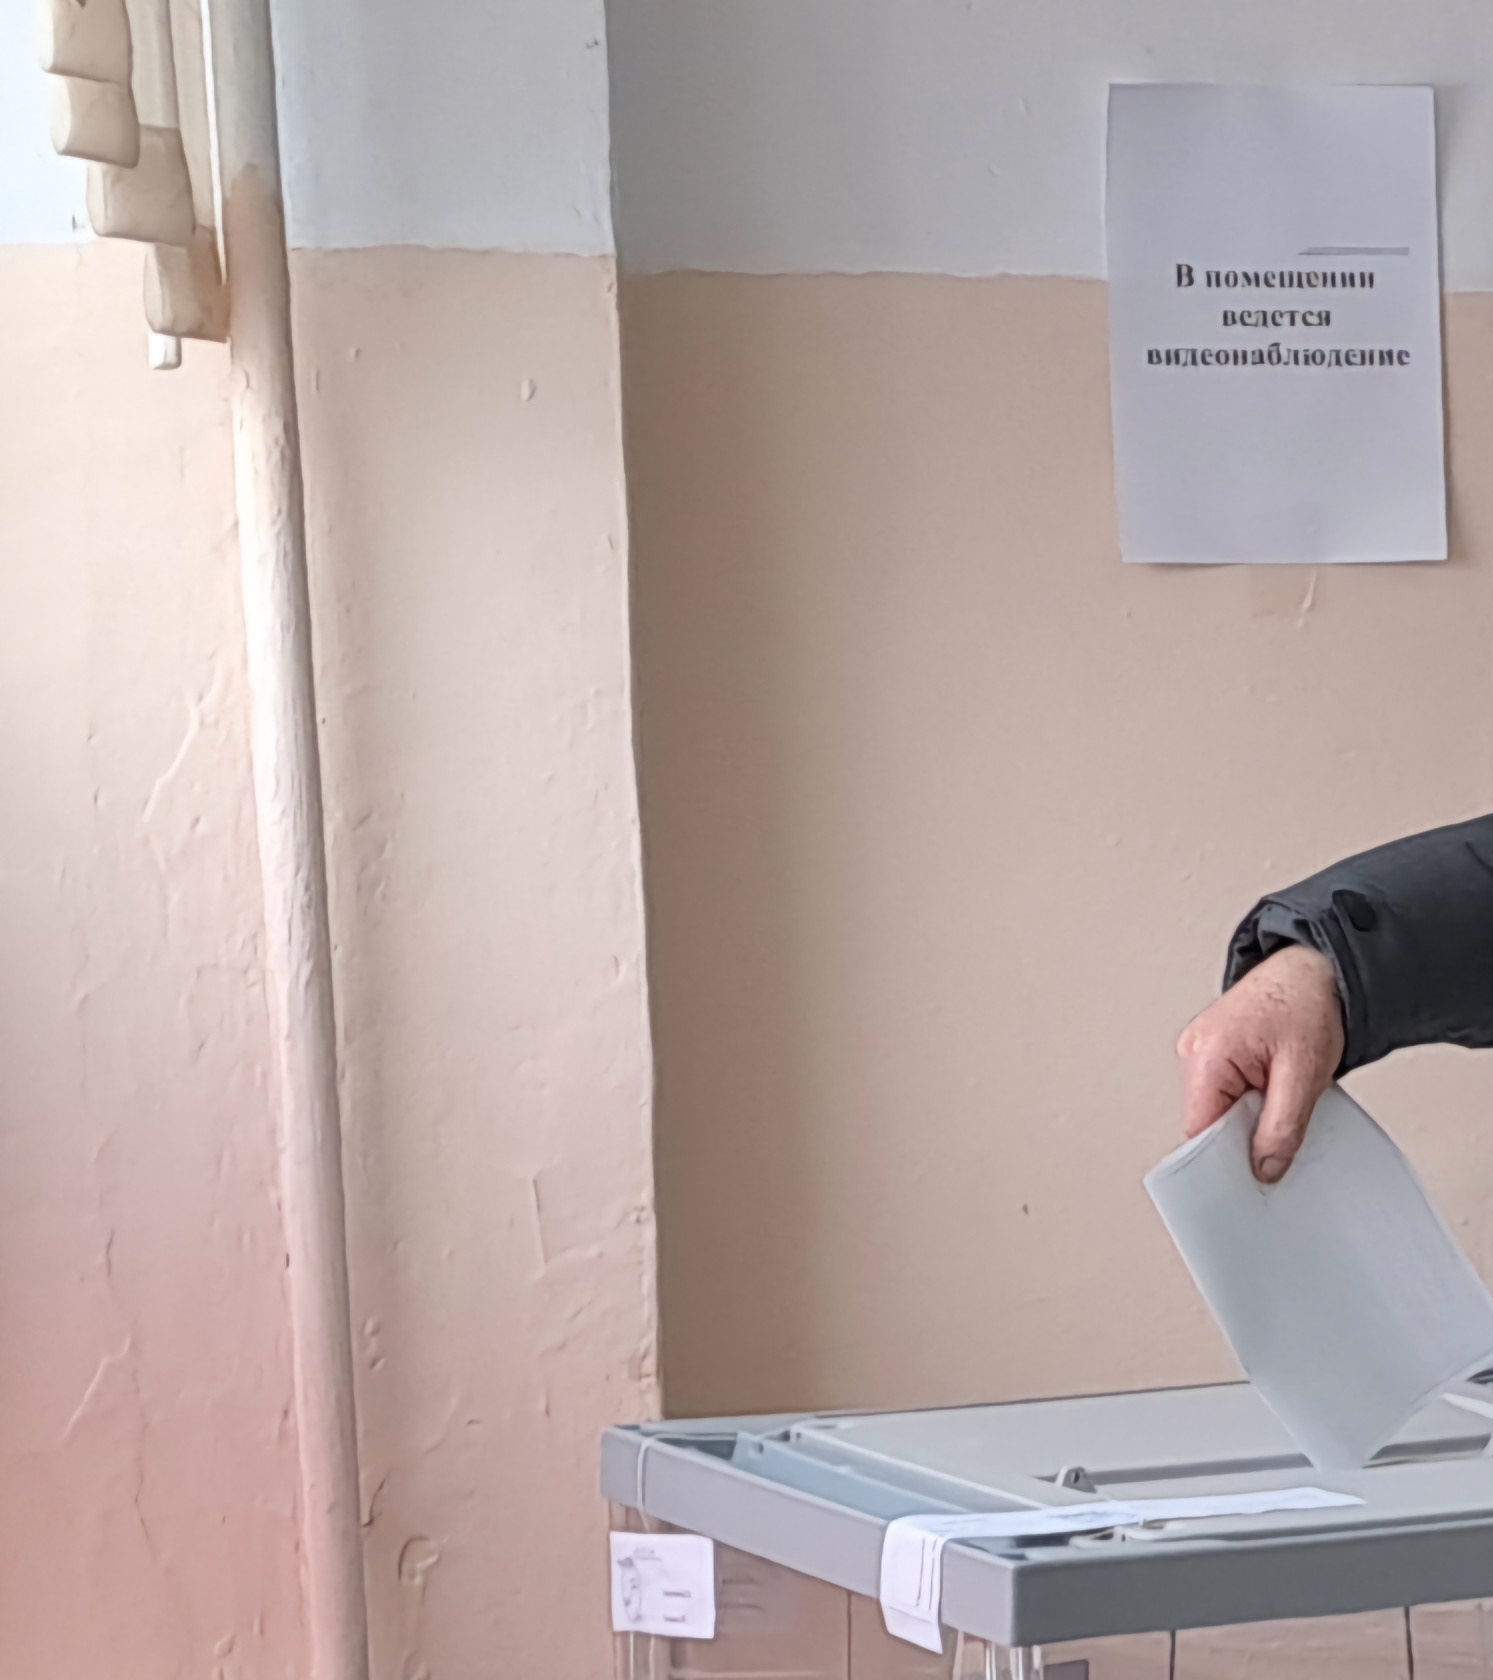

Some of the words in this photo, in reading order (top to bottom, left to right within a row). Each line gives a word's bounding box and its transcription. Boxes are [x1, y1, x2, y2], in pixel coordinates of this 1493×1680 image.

[1175, 262, 1195, 288] В
[1204, 269, 1375, 289] помещении
[1222, 309, 1332, 328] ведется
[1146, 341, 1412, 368] видеонаблюдение
